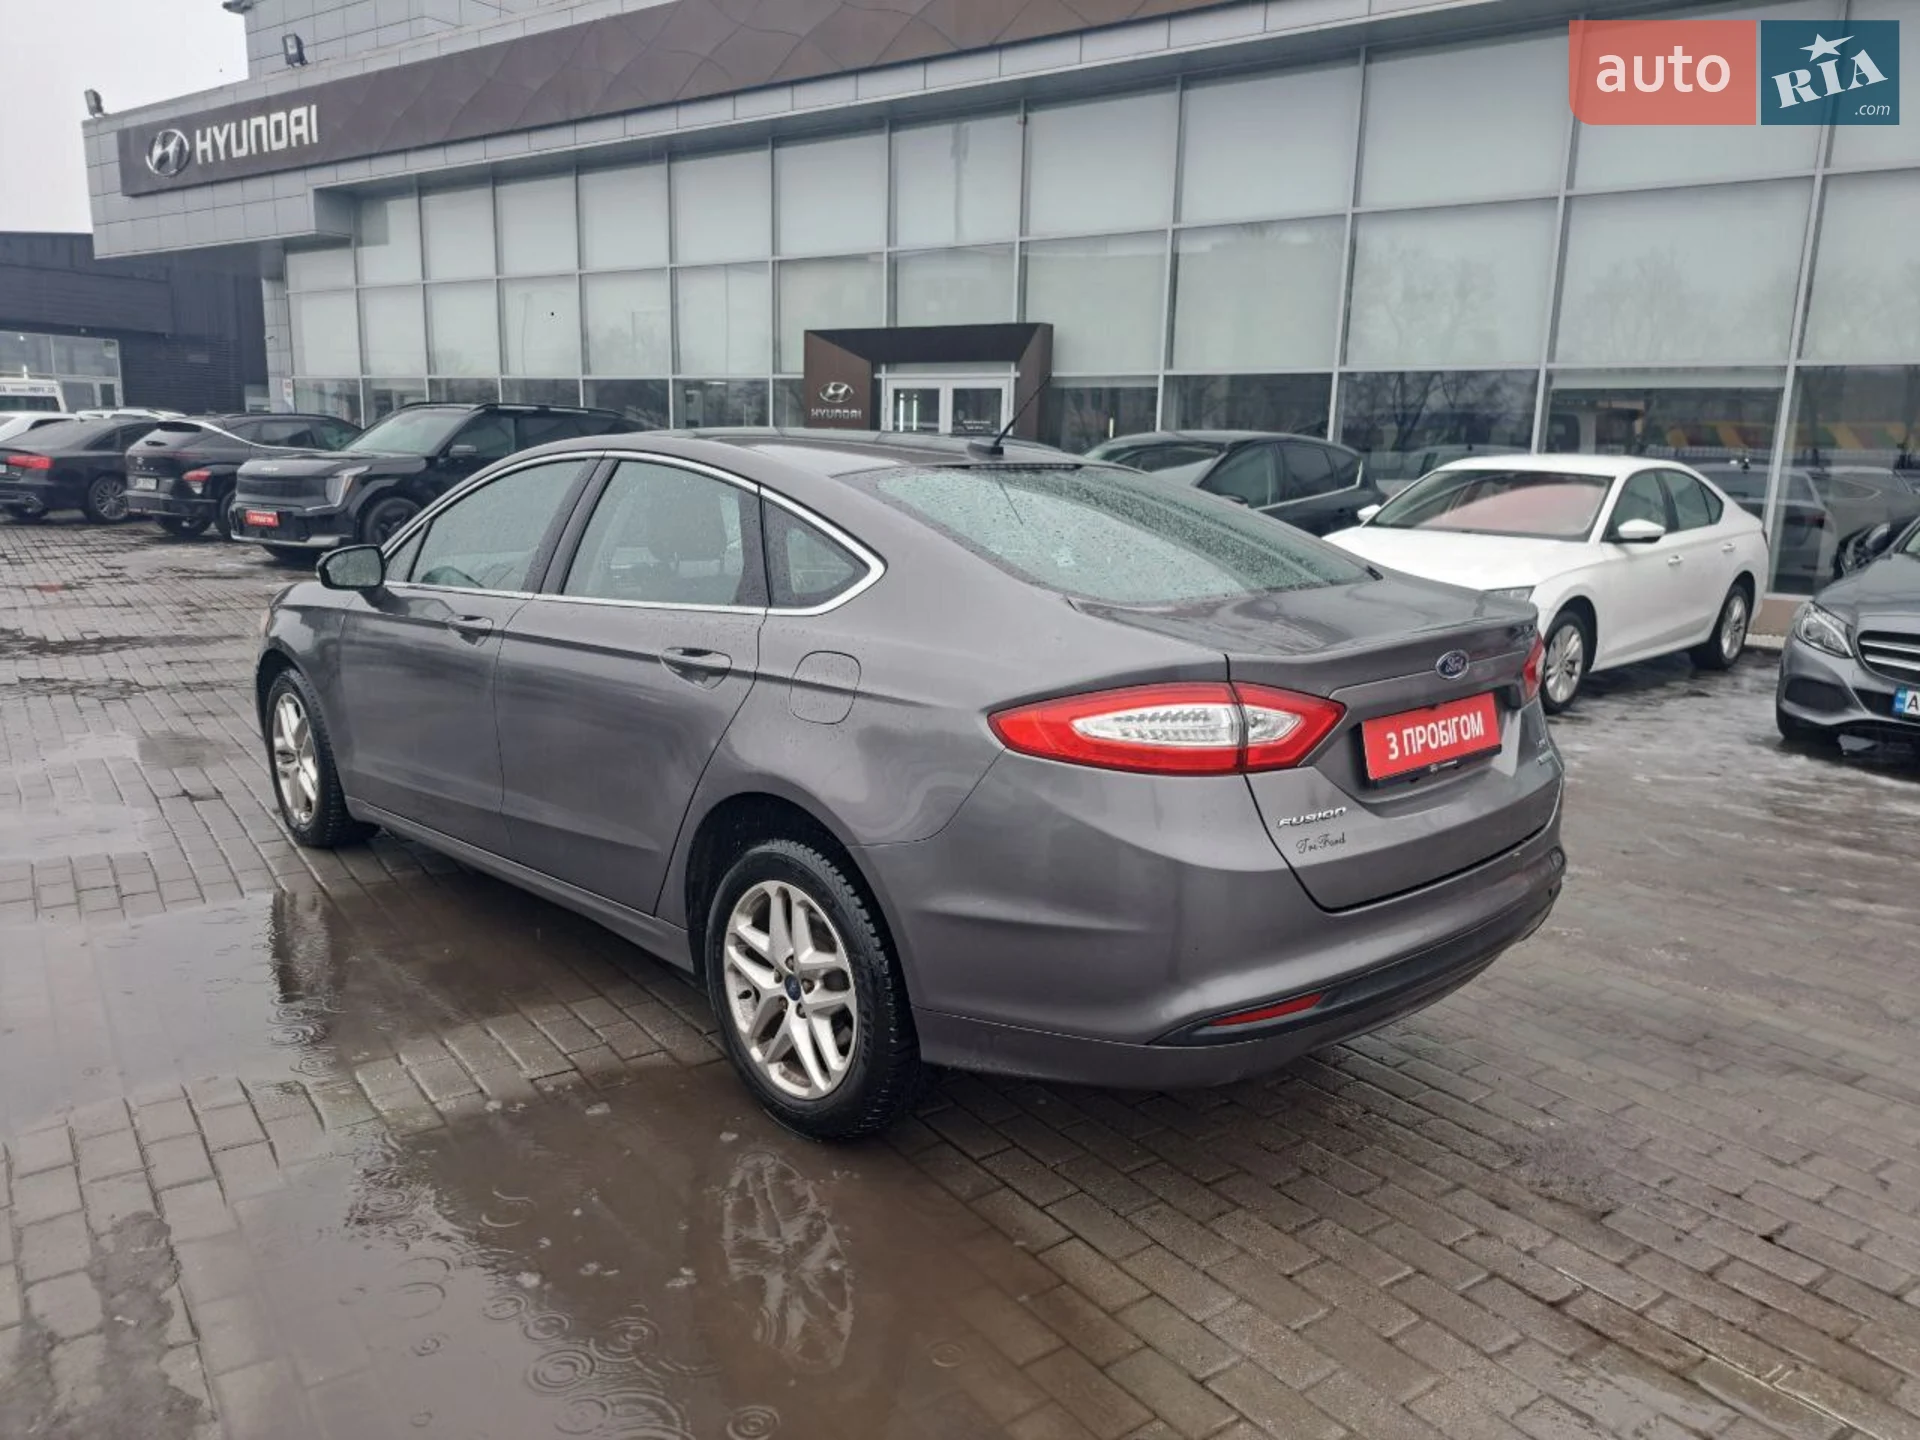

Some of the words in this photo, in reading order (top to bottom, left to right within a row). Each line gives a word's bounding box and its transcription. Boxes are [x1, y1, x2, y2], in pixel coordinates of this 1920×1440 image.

[195, 105, 318, 164] HYUNDAI
[810, 408, 863, 420] HYUNDAI
[1402, 711, 1484, 756] ПРОБІГОМ
[1278, 806, 1347, 828] FUSION
